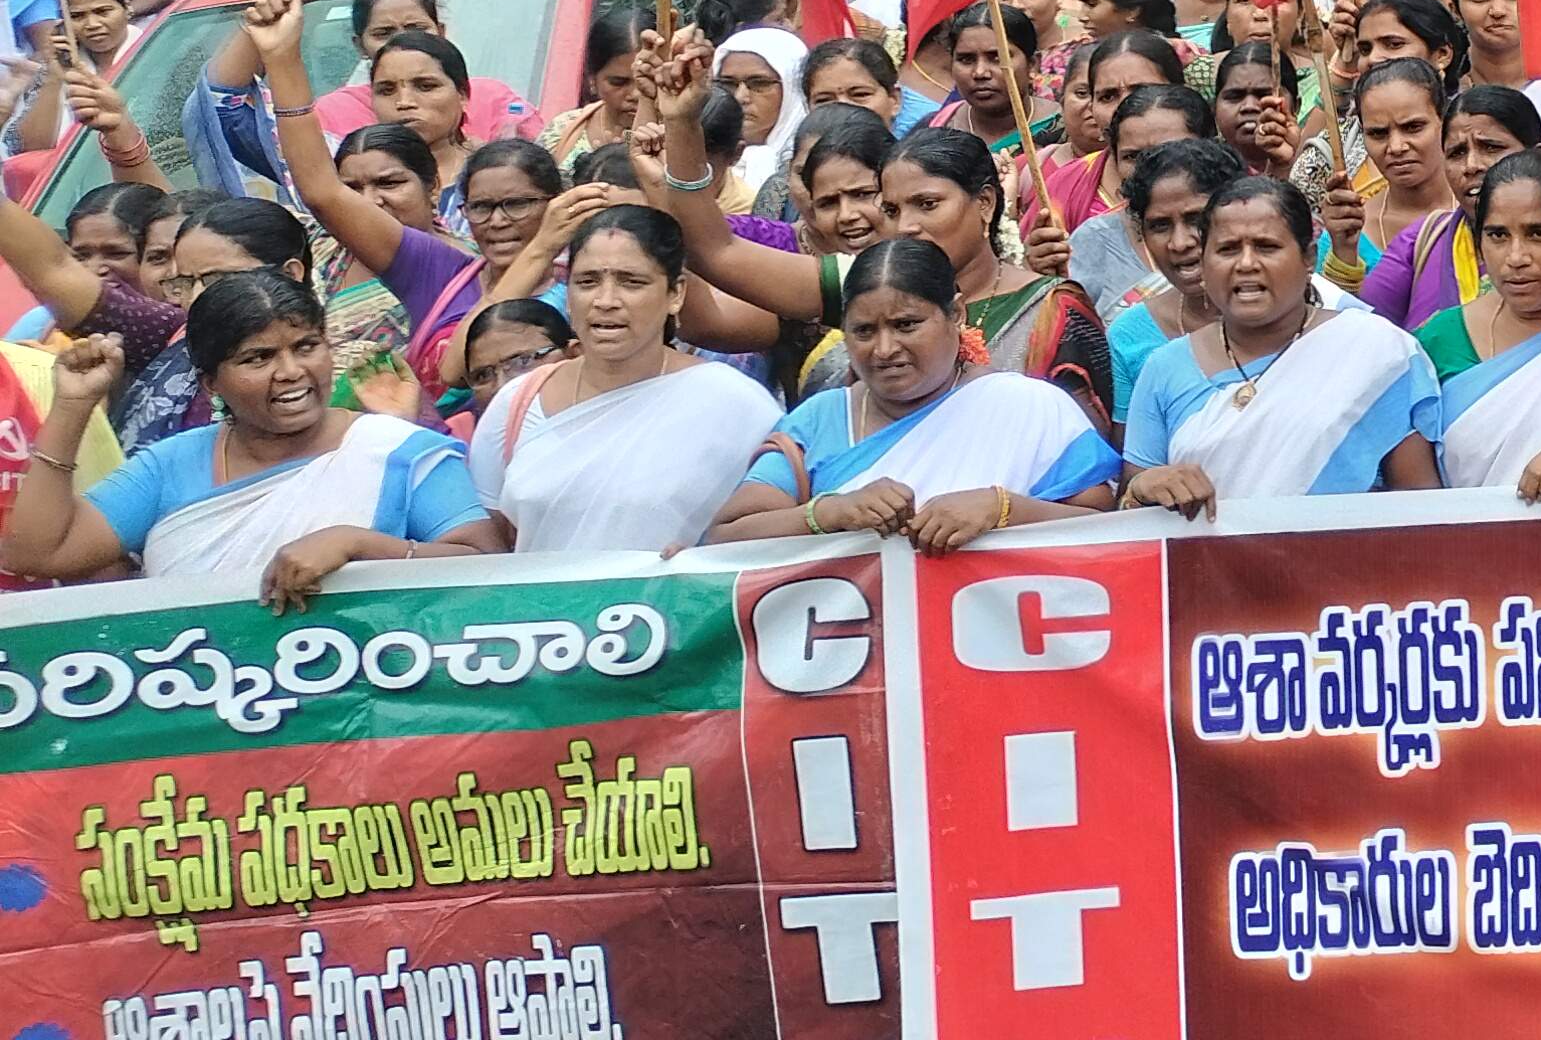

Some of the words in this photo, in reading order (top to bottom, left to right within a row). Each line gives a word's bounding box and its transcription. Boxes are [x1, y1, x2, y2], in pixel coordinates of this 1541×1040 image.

[74, 773, 233, 953] సంక్షేమ
[409, 770, 554, 886] అమలు
[556, 738, 711, 877] చేయాలి.
[1235, 833, 1451, 973] అధికారుల
